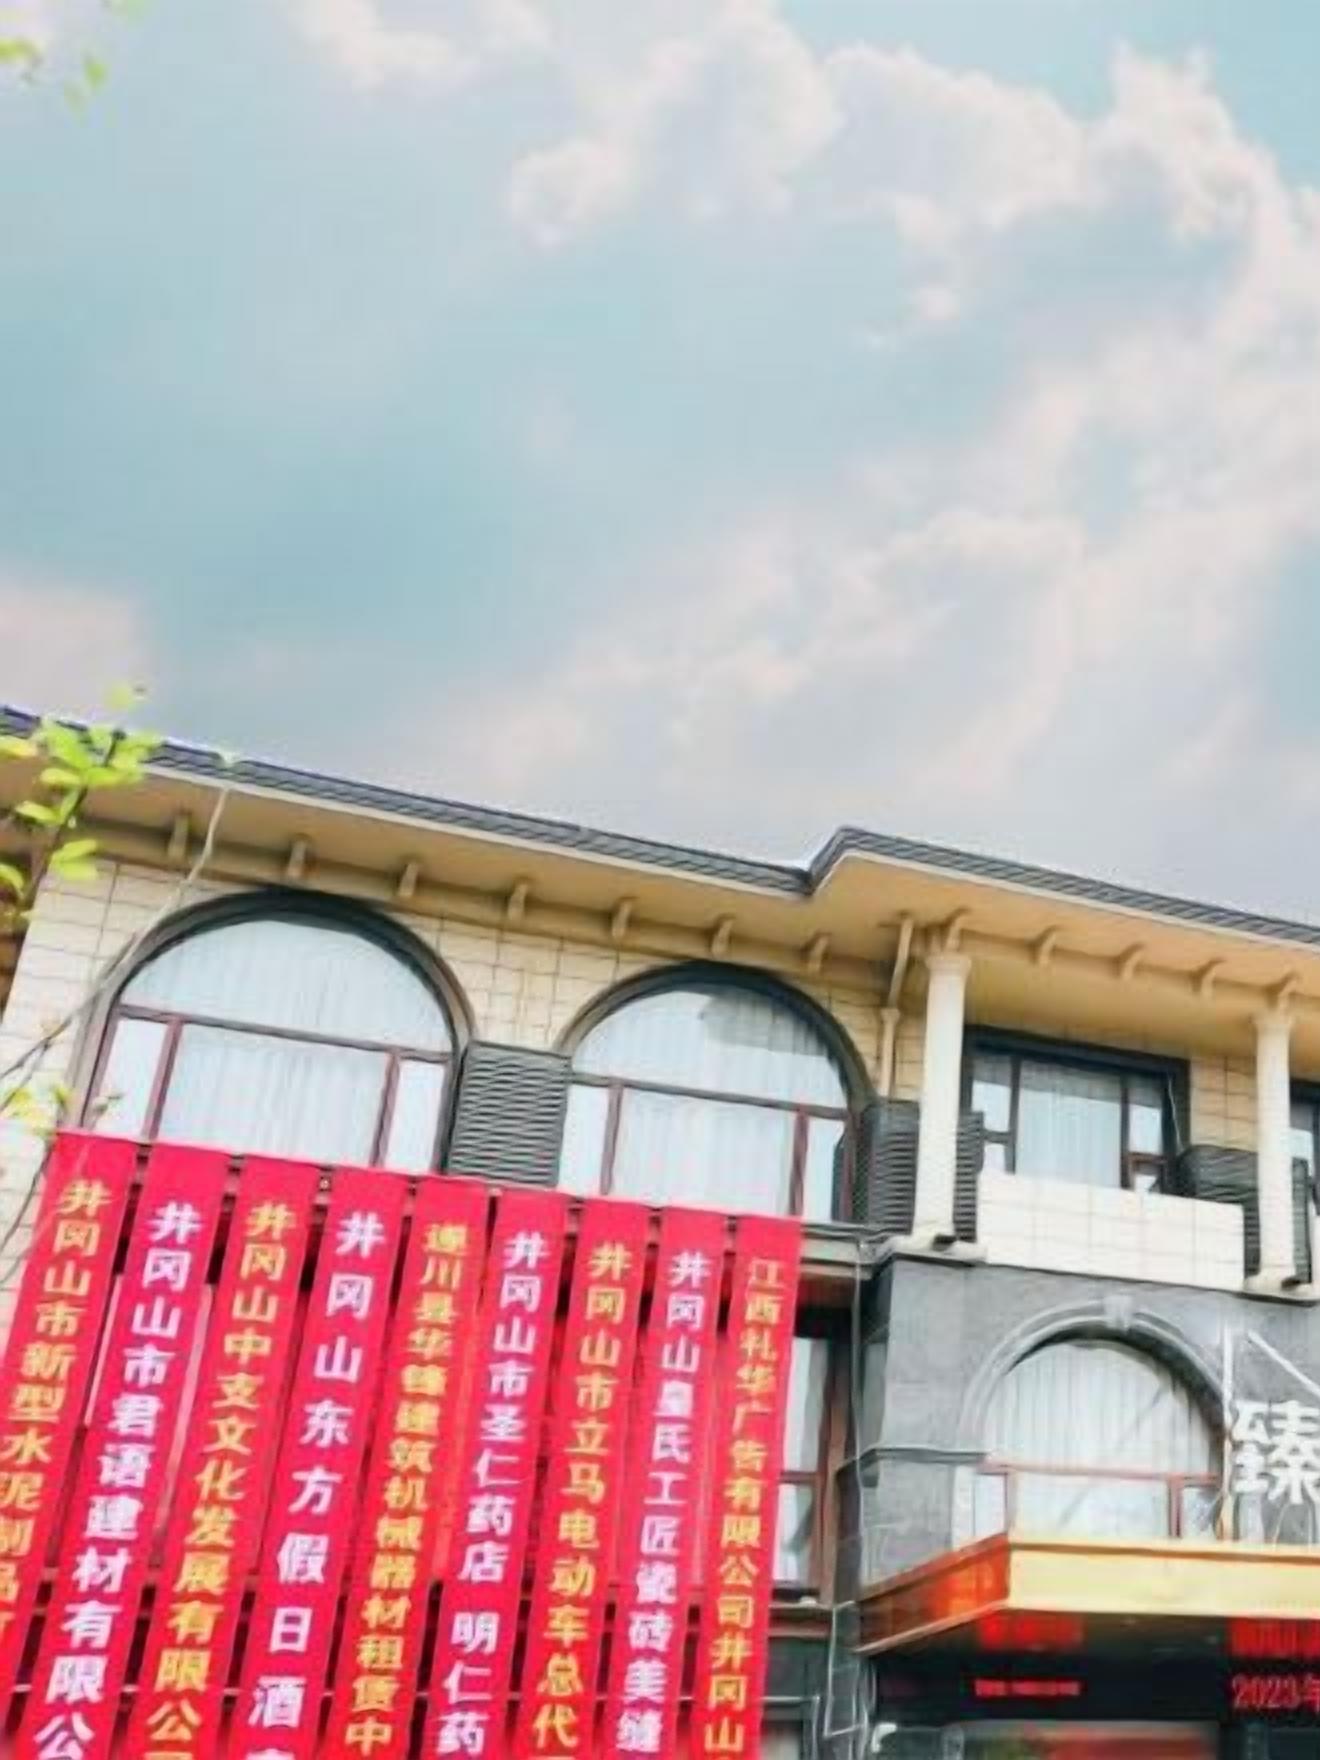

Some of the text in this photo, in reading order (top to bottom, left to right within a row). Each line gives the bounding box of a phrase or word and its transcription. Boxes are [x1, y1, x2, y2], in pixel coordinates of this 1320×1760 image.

[246, 1210, 386, 1760] 井冈山东方假日酒
[530, 1241, 633, 1760] 井冈山市立马电动车总代
[704, 1257, 785, 1760] 江西礼华广告有限公司井冈山
